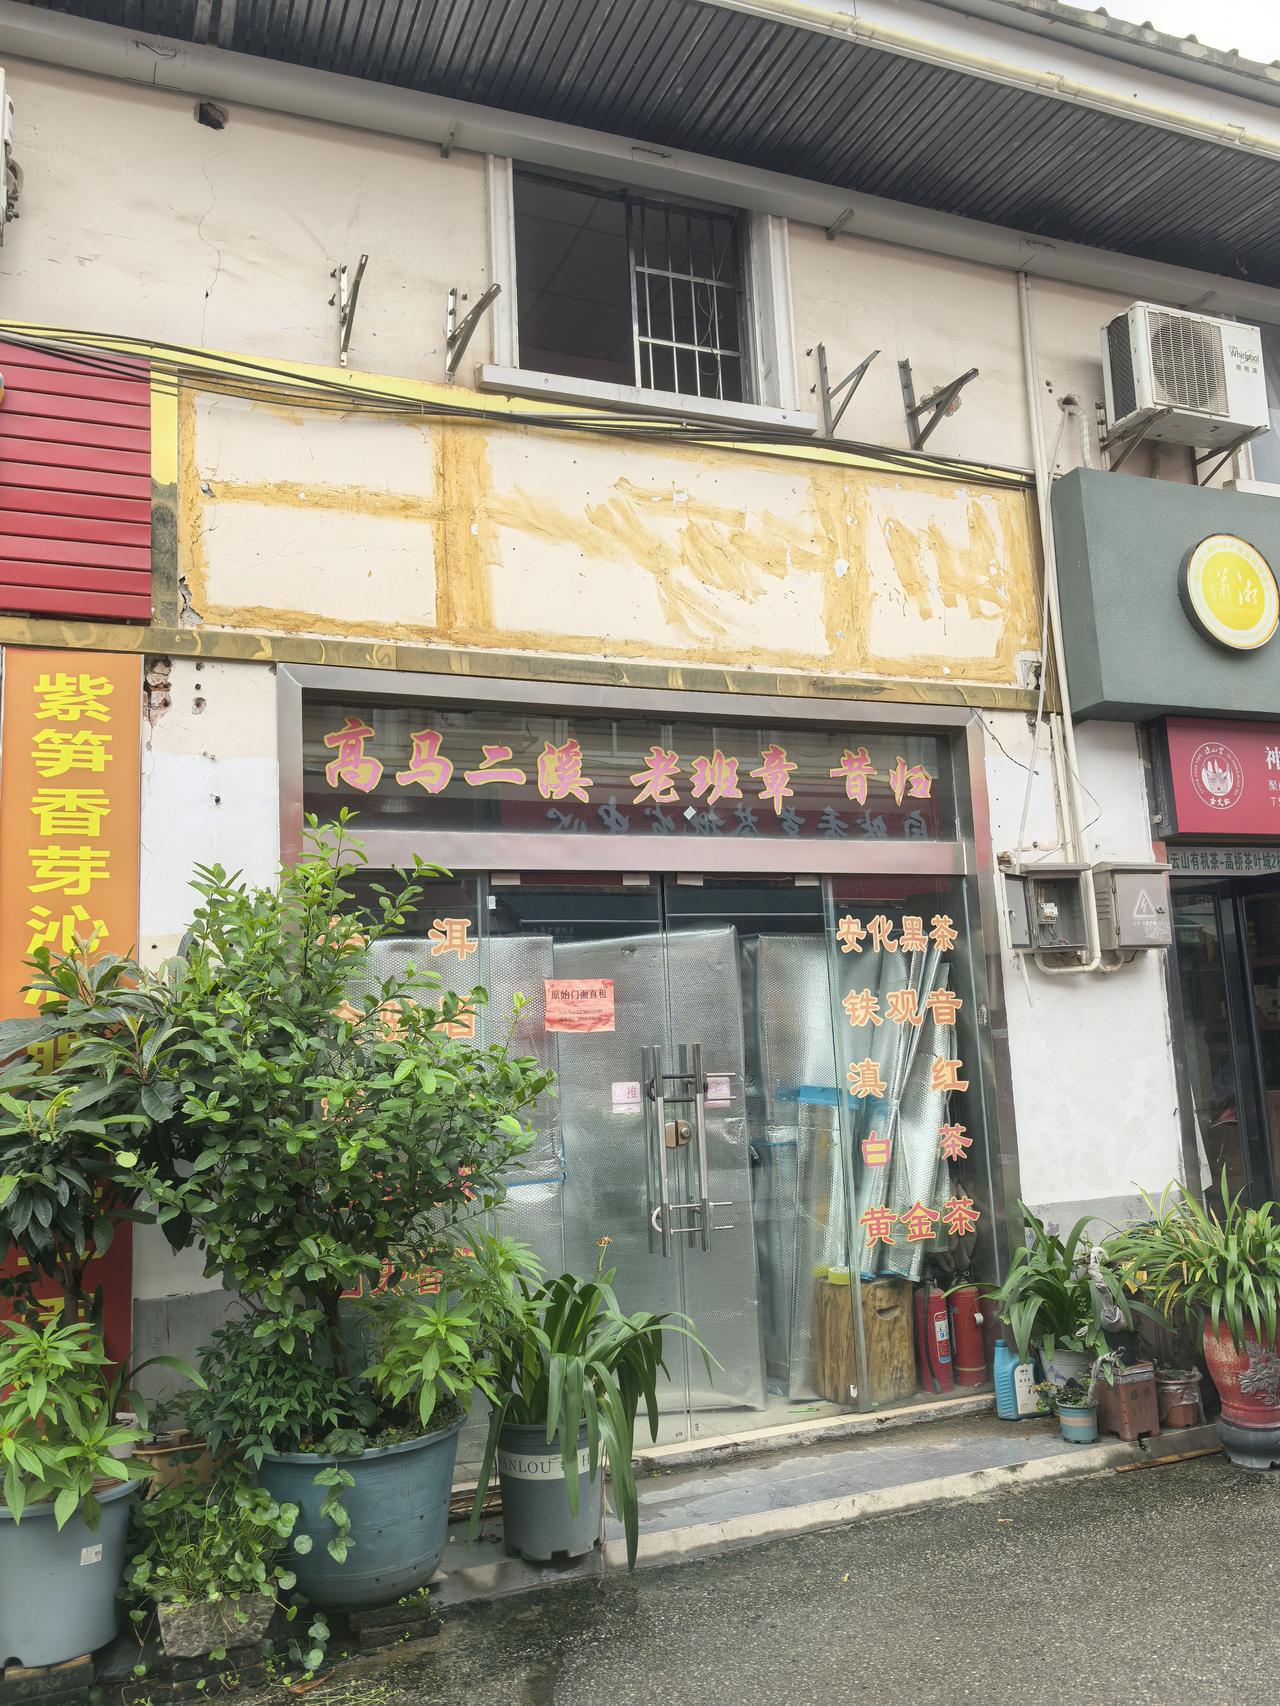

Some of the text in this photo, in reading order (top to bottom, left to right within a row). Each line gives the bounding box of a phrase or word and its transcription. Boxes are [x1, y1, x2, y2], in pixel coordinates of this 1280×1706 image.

[1229, 350, 1259, 363] Whirlpool
[324, 717, 933, 816] 高马二溪 老班章 昔归
[1170, 851, 1280, 871] 云山有机茶-高桥茶叶城2
[837, 914, 958, 953] 安化黑茶
[842, 988, 963, 1027] 铁观音
[847, 1056, 970, 1098] 滇红
[861, 1122, 974, 1168] 白茶
[858, 1196, 981, 1249] 黄金茶
